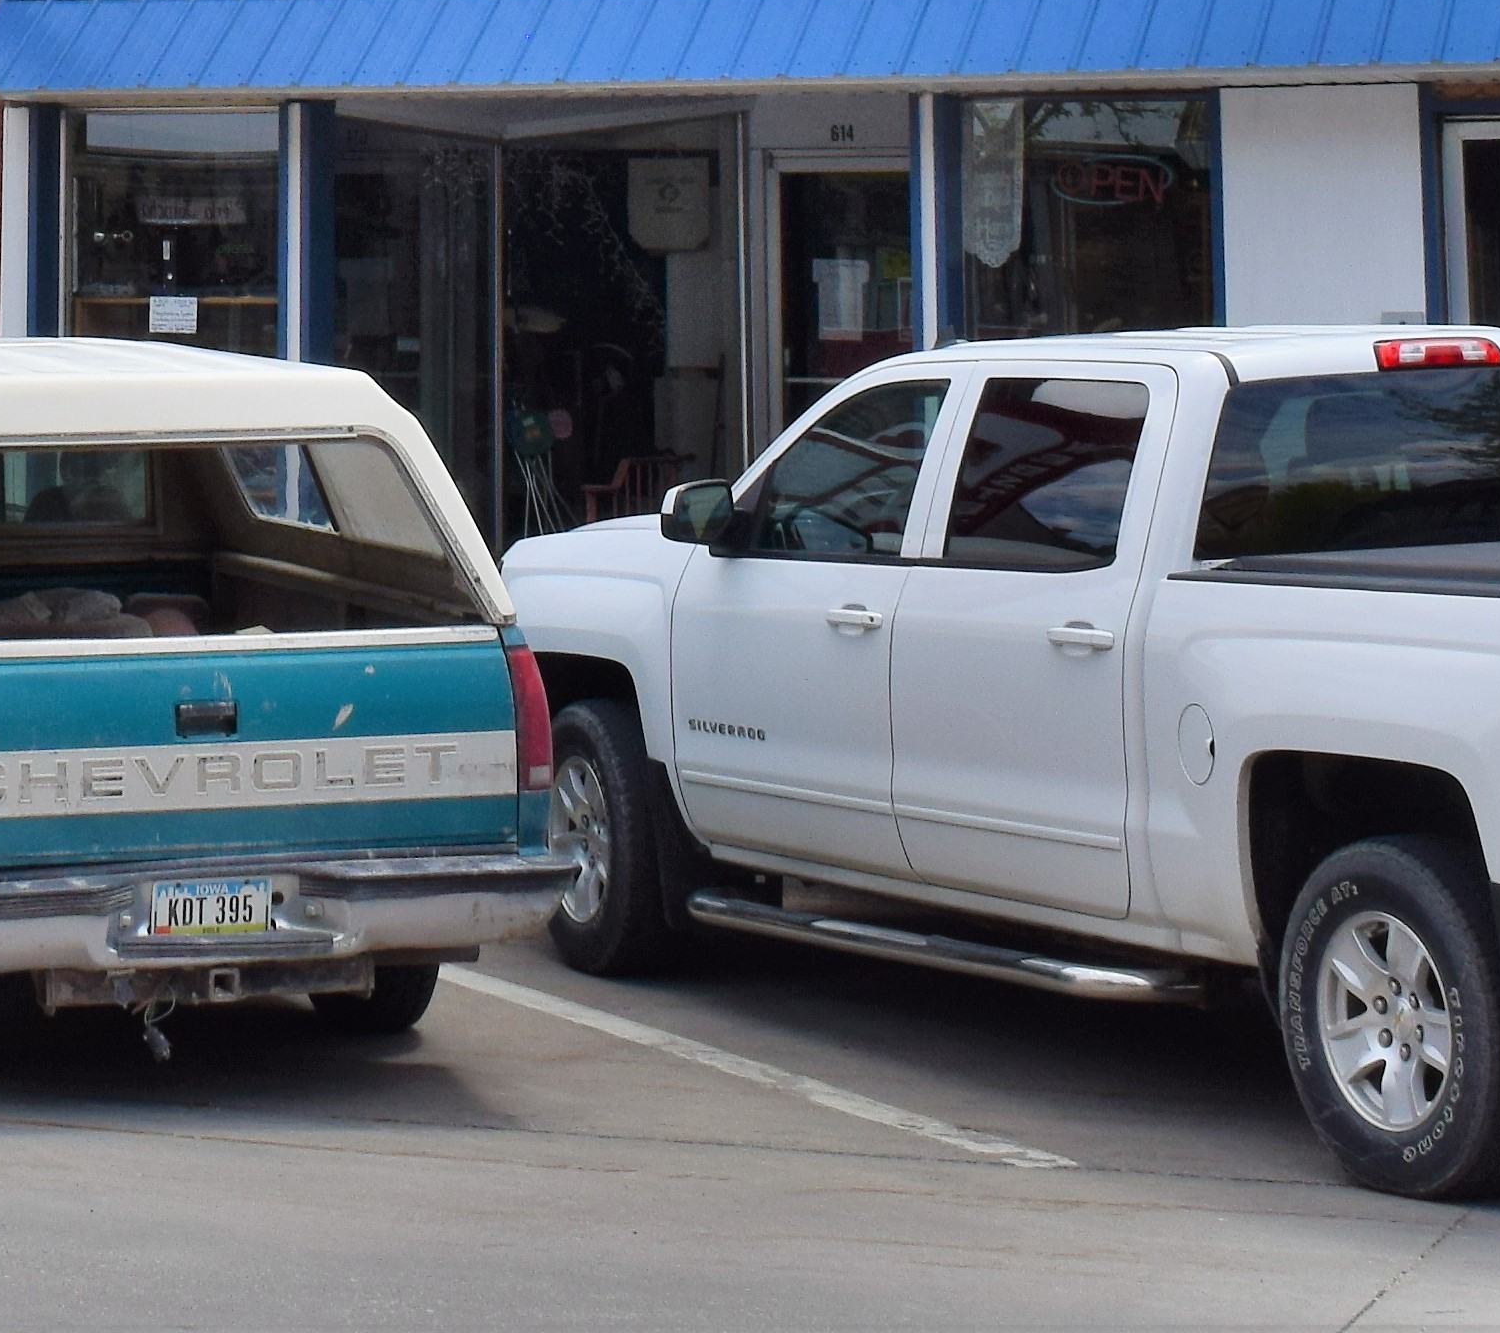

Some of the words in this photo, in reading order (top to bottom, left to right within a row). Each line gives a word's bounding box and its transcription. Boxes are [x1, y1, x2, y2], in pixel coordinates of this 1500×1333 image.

[829, 123, 855, 144] 614
[1057, 161, 1166, 205] OPEN
[688, 718, 766, 741] SILVERADO
[196, 883, 229, 894] IOWA
[215, 894, 253, 924] 395
